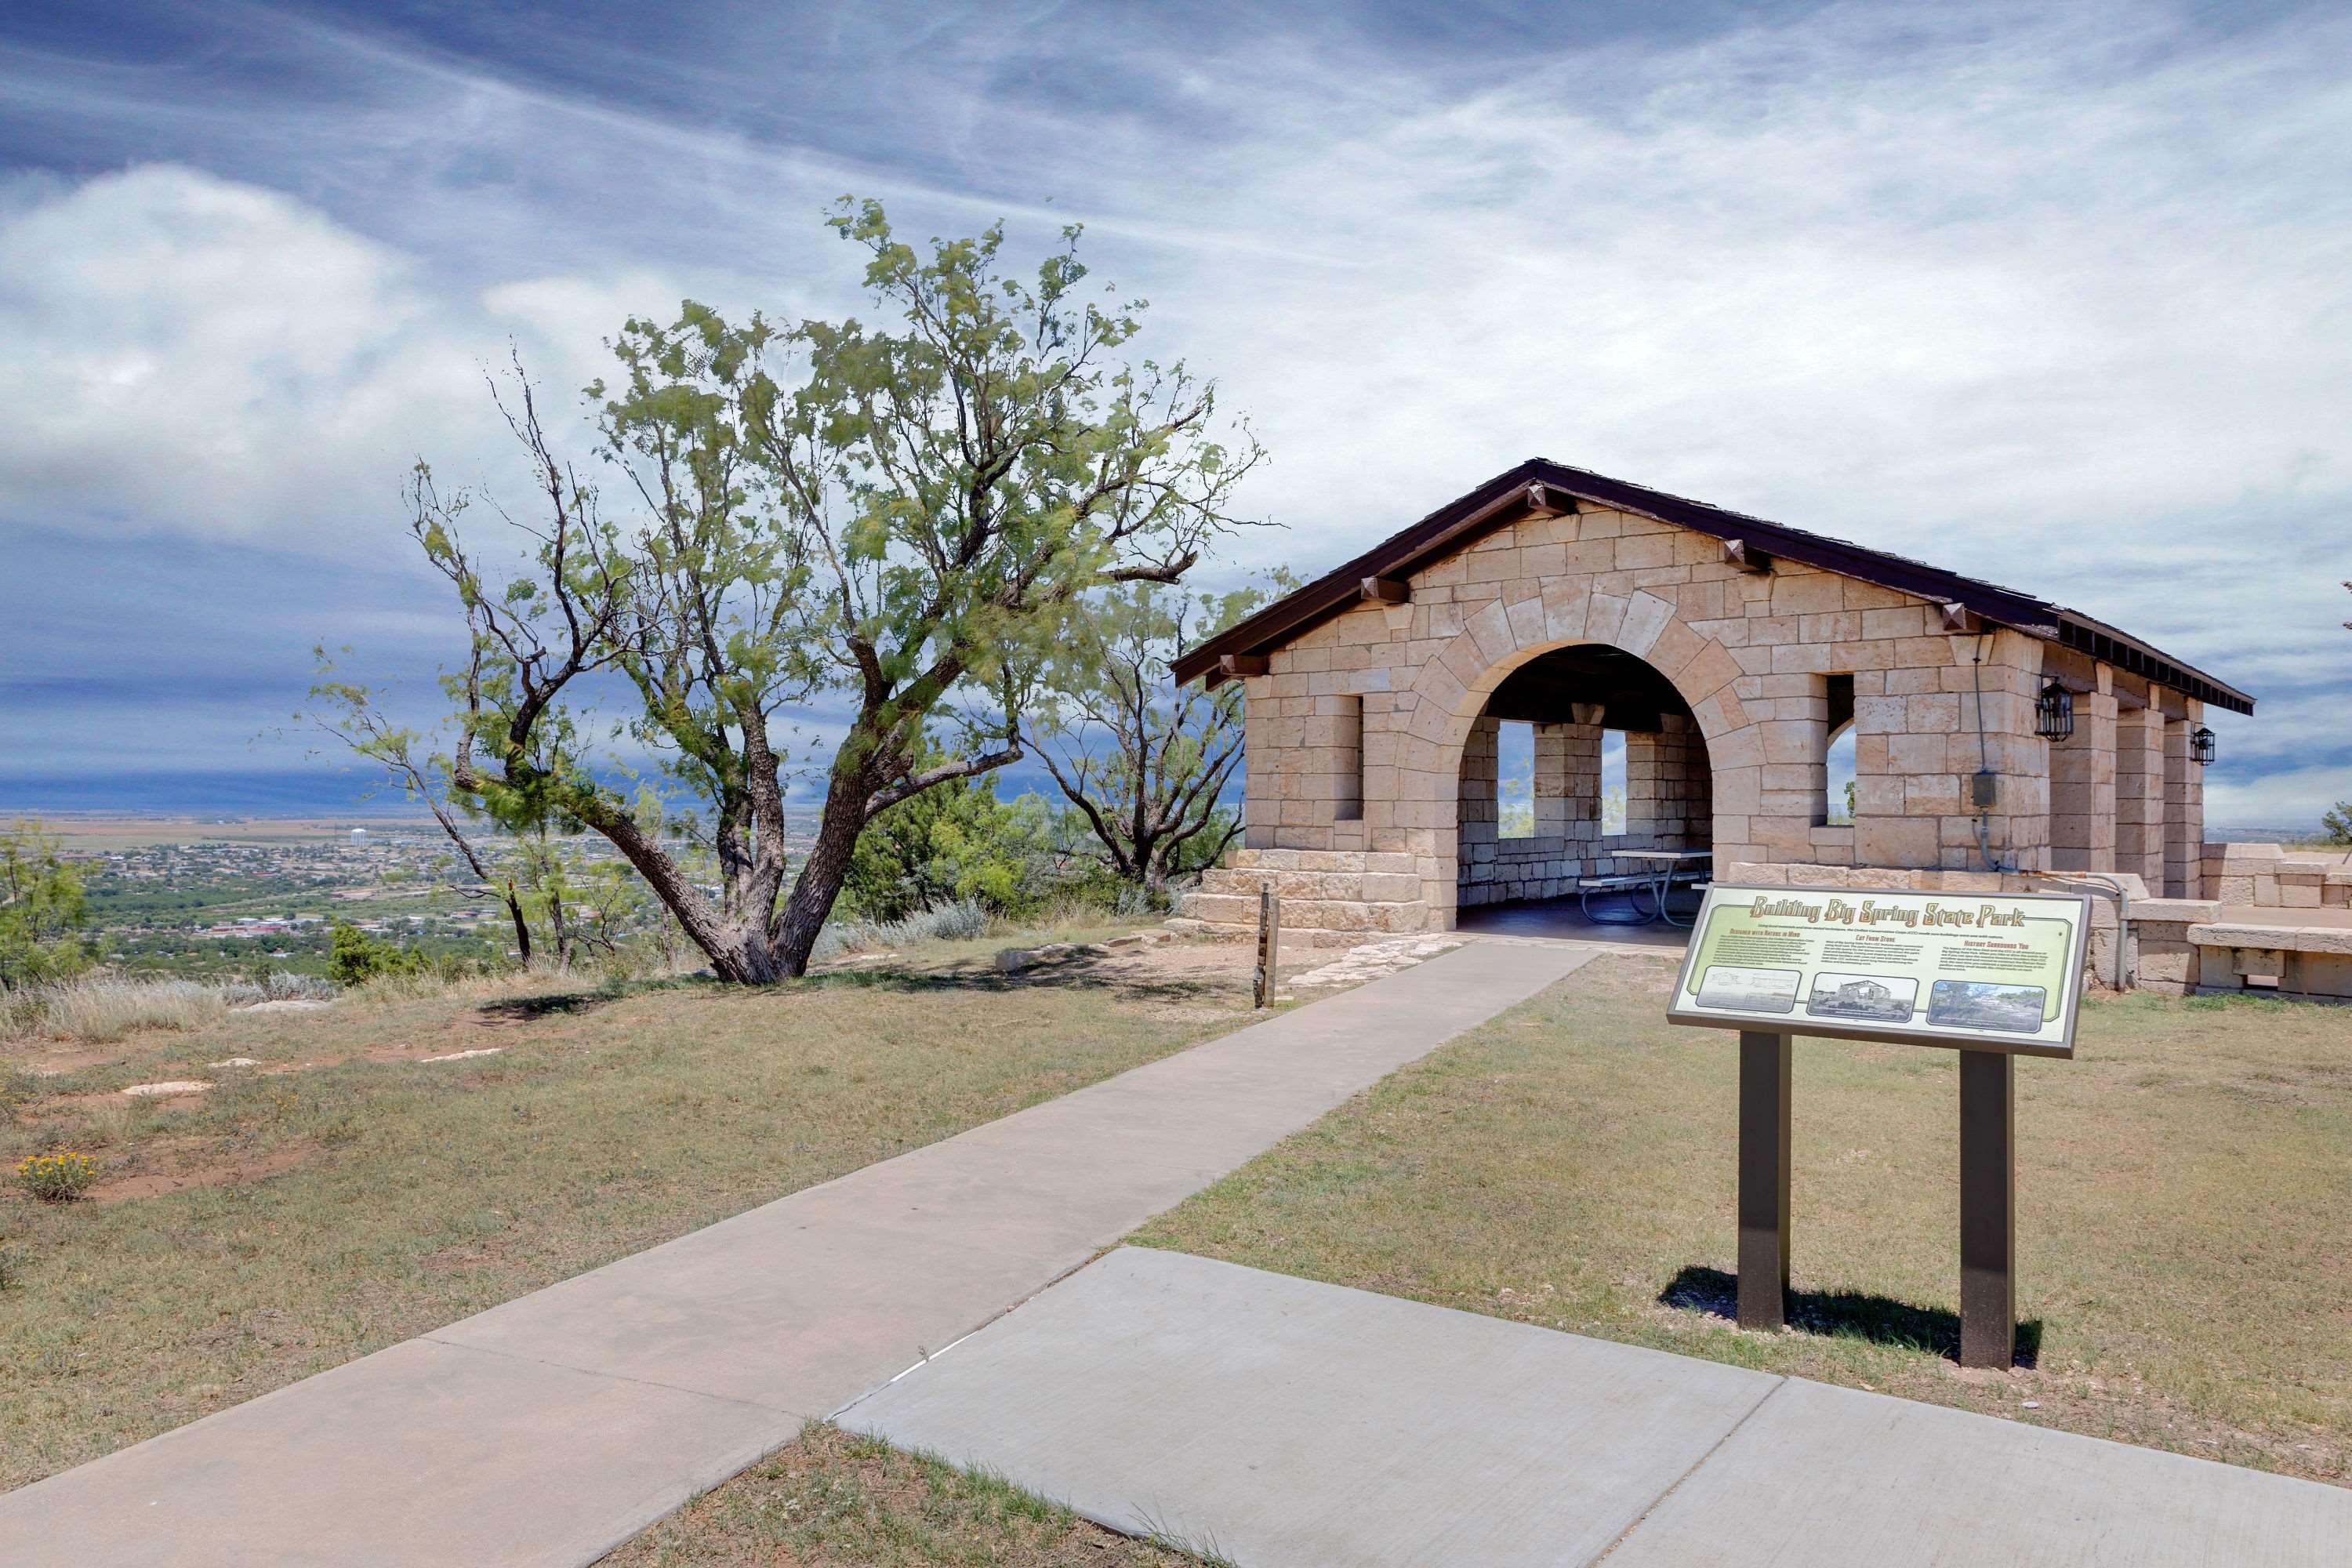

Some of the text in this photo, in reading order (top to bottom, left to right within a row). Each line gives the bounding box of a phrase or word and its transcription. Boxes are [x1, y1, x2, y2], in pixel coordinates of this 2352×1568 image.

[1750, 896, 2025, 928] Building Big Spring State Park
